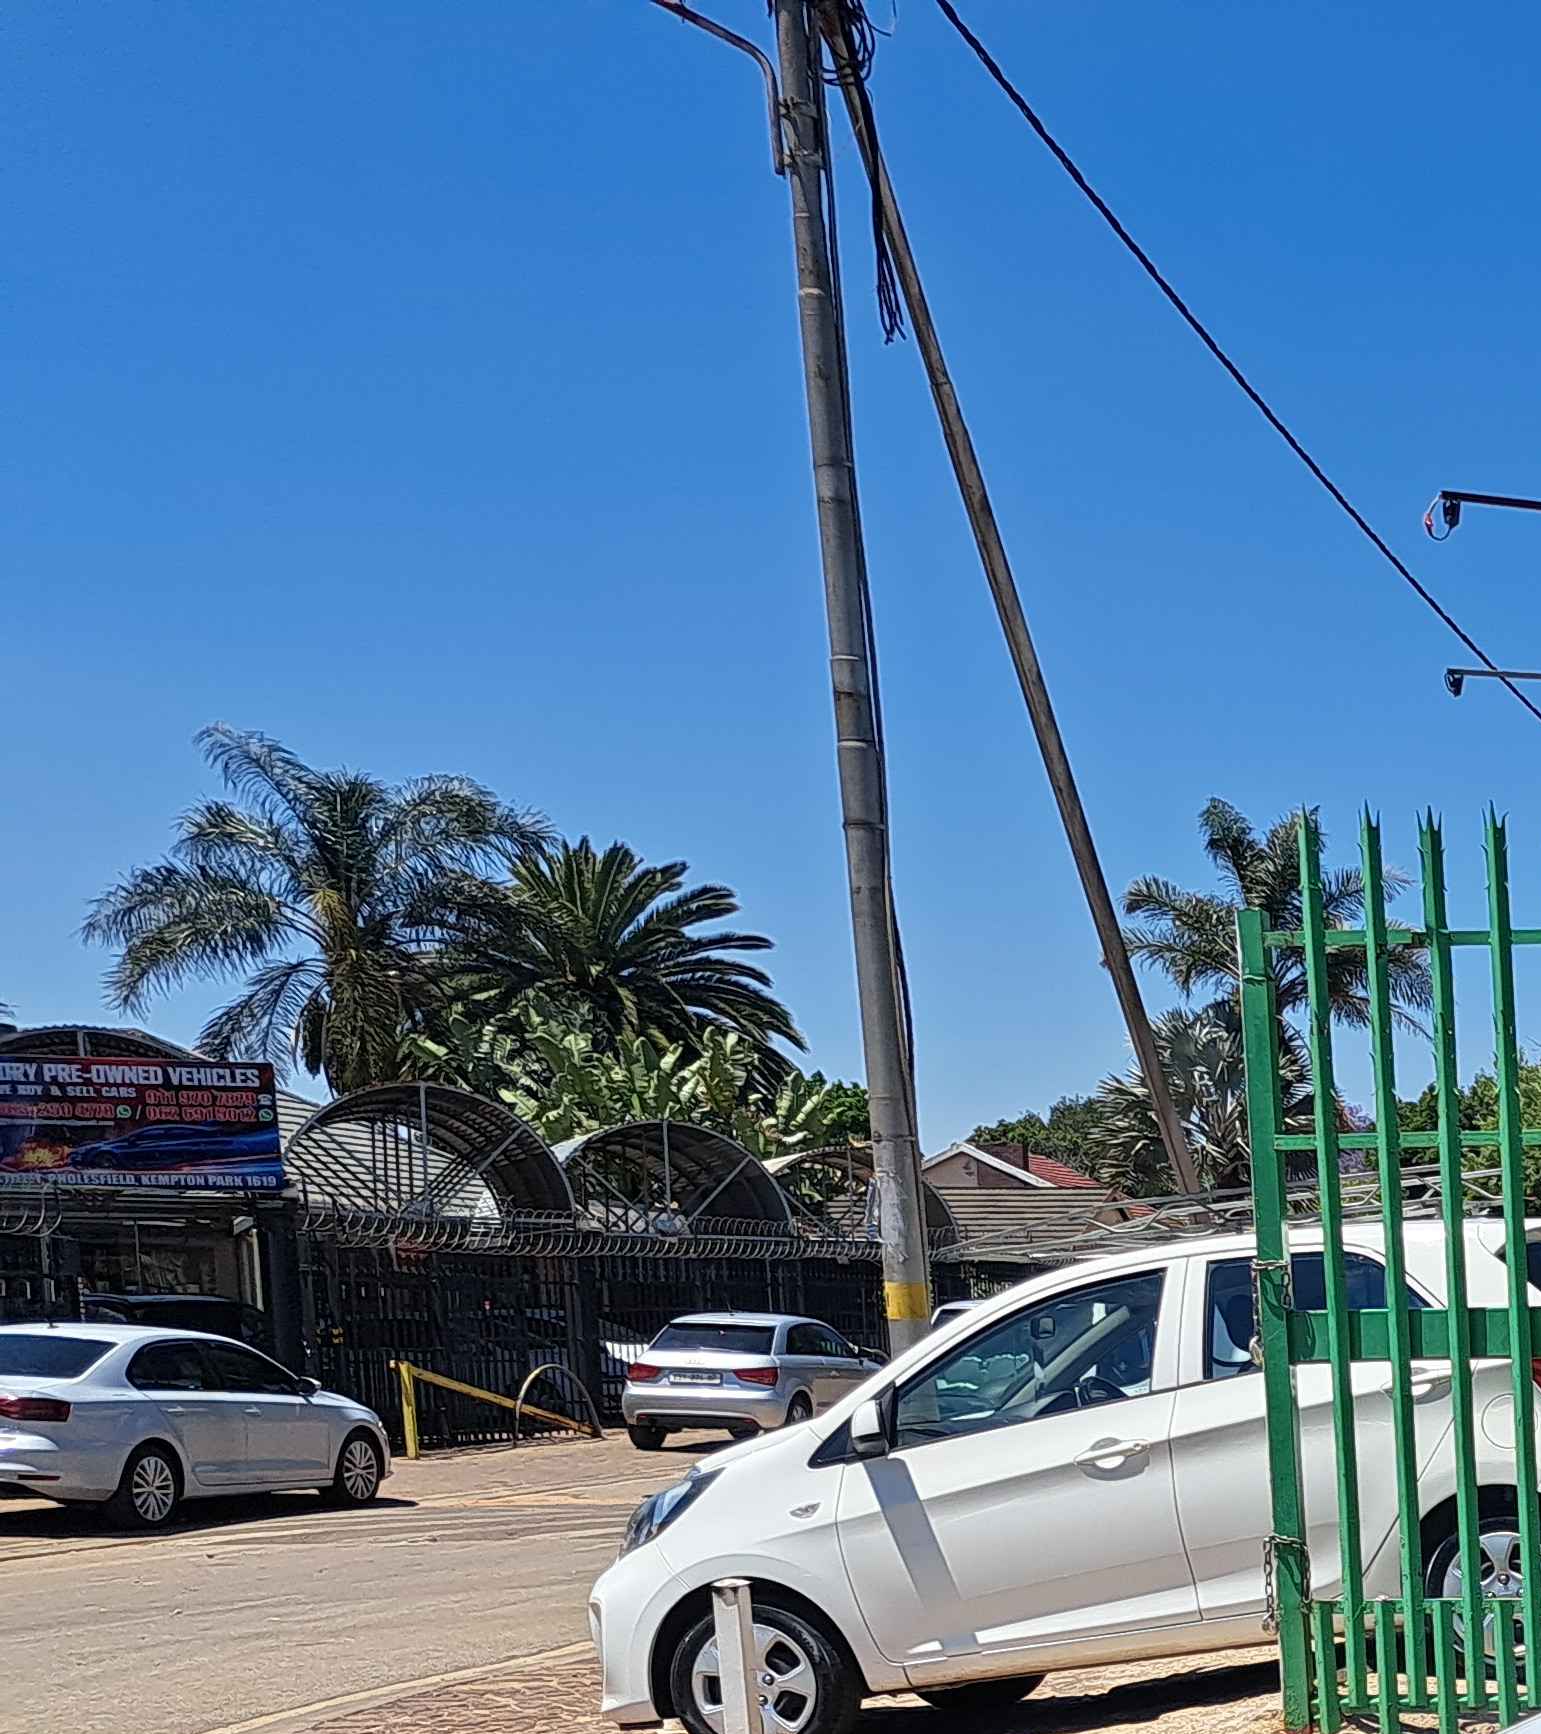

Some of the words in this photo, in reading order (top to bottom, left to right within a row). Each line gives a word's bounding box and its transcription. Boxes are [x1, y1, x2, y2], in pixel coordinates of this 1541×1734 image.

[42, 1063, 163, 1086] PRE-OWNED
[166, 1066, 260, 1088] VEHICLES
[101, 1086, 137, 1098] CARS
[141, 1174, 206, 1187] KEMPTON
[207, 1175, 243, 1187] PARK
[246, 1175, 277, 1187] 1619
